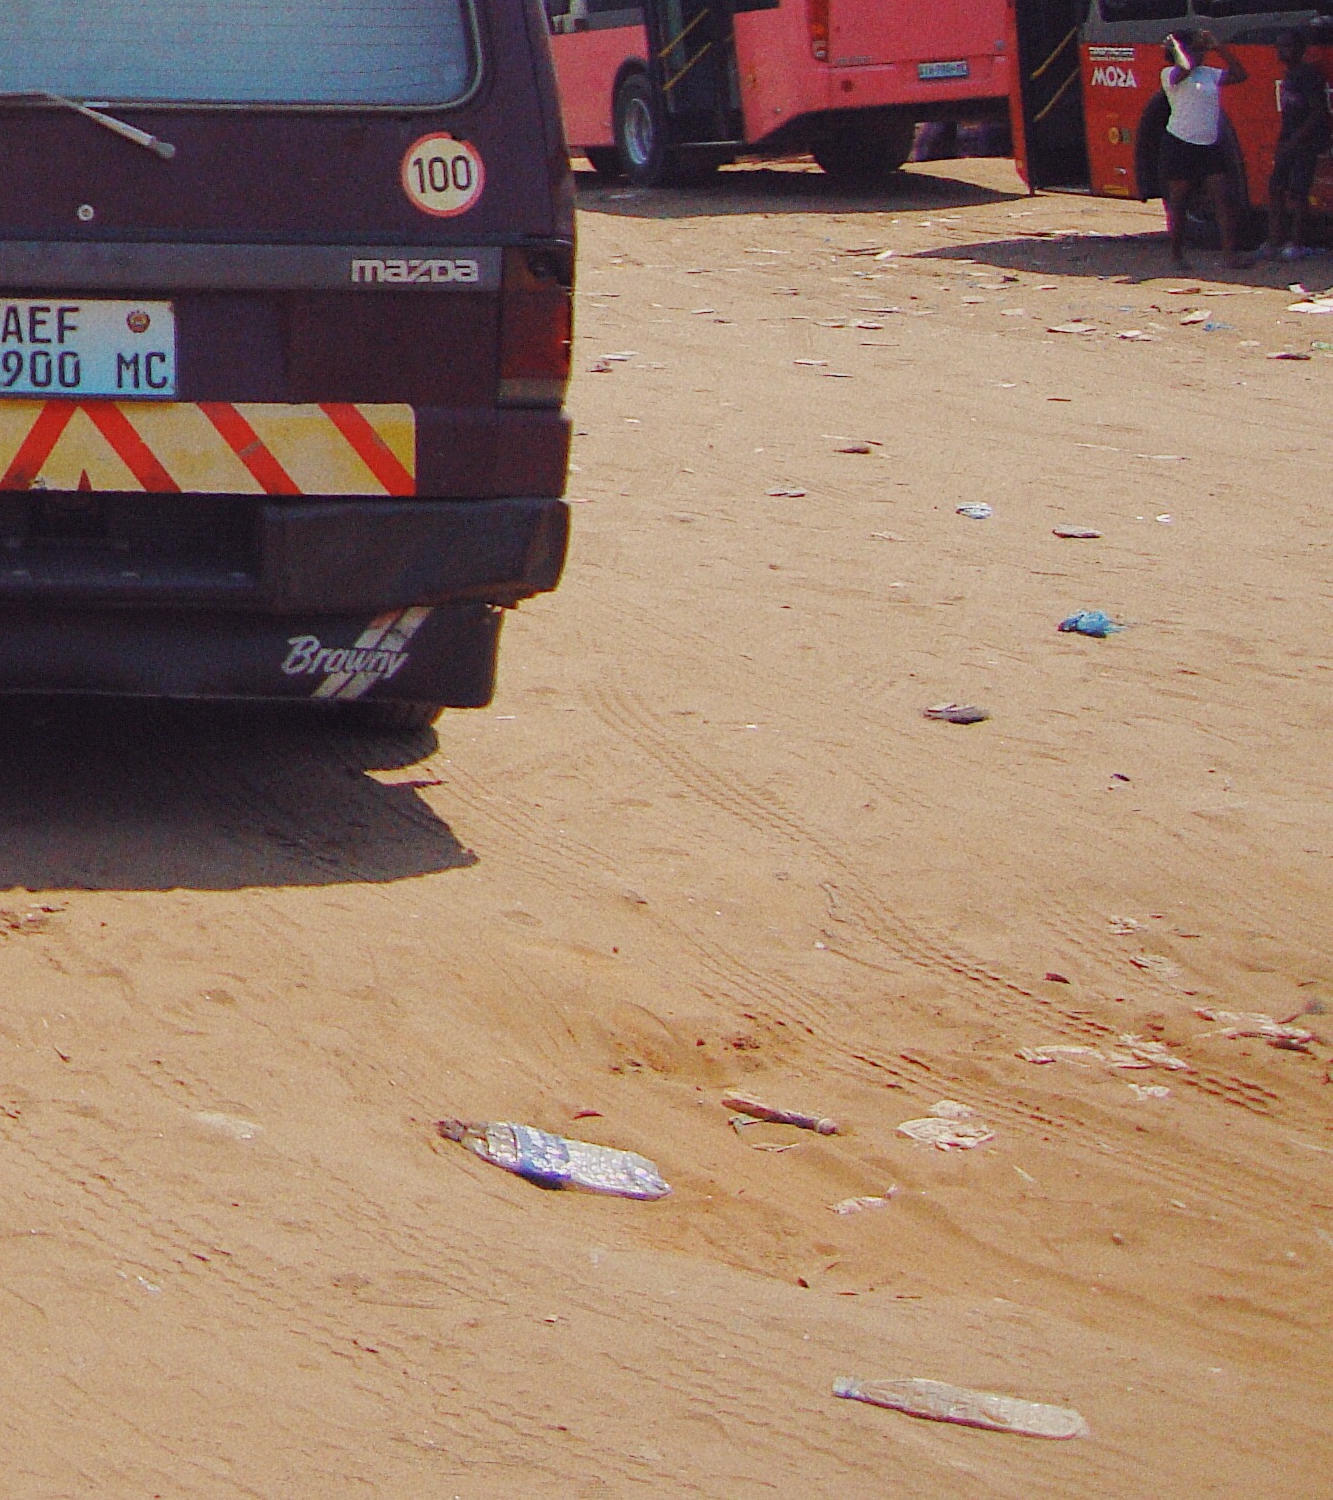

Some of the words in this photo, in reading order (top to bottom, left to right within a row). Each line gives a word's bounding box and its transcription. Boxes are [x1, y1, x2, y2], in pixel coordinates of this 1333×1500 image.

[413, 155, 471, 194] 100
[1, 305, 79, 344] AEF
[2, 350, 81, 388] 900
[116, 351, 167, 389] MC
[281, 634, 409, 679] Brawny
